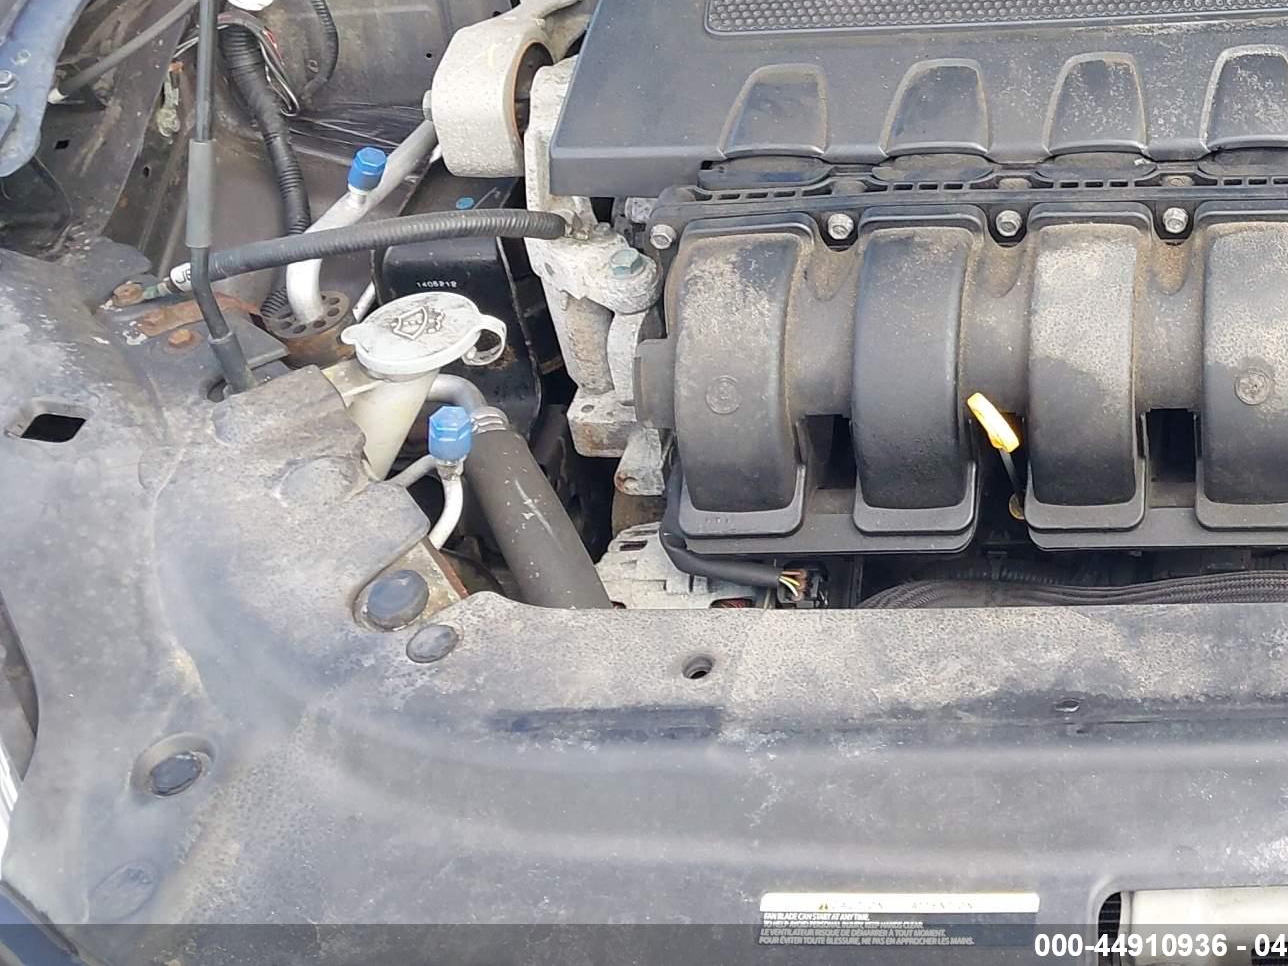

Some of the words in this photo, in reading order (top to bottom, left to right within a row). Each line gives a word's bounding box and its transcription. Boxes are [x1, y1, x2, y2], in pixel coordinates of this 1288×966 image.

[763, 913, 777, 921] FAN
[777, 913, 798, 921] BLADE
[798, 913, 811, 921] CAN
[840, 913, 854, 921] ANY
[763, 920, 772, 928] TO
[772, 920, 789, 928] HELP
[809, 920, 841, 929] PERSONAL
[894, 929, 914, 937] TOUT
[759, 936, 780, 944] POUR
[803, 936, 826, 944] TOUTE
[938, 937, 949, 945] LES
